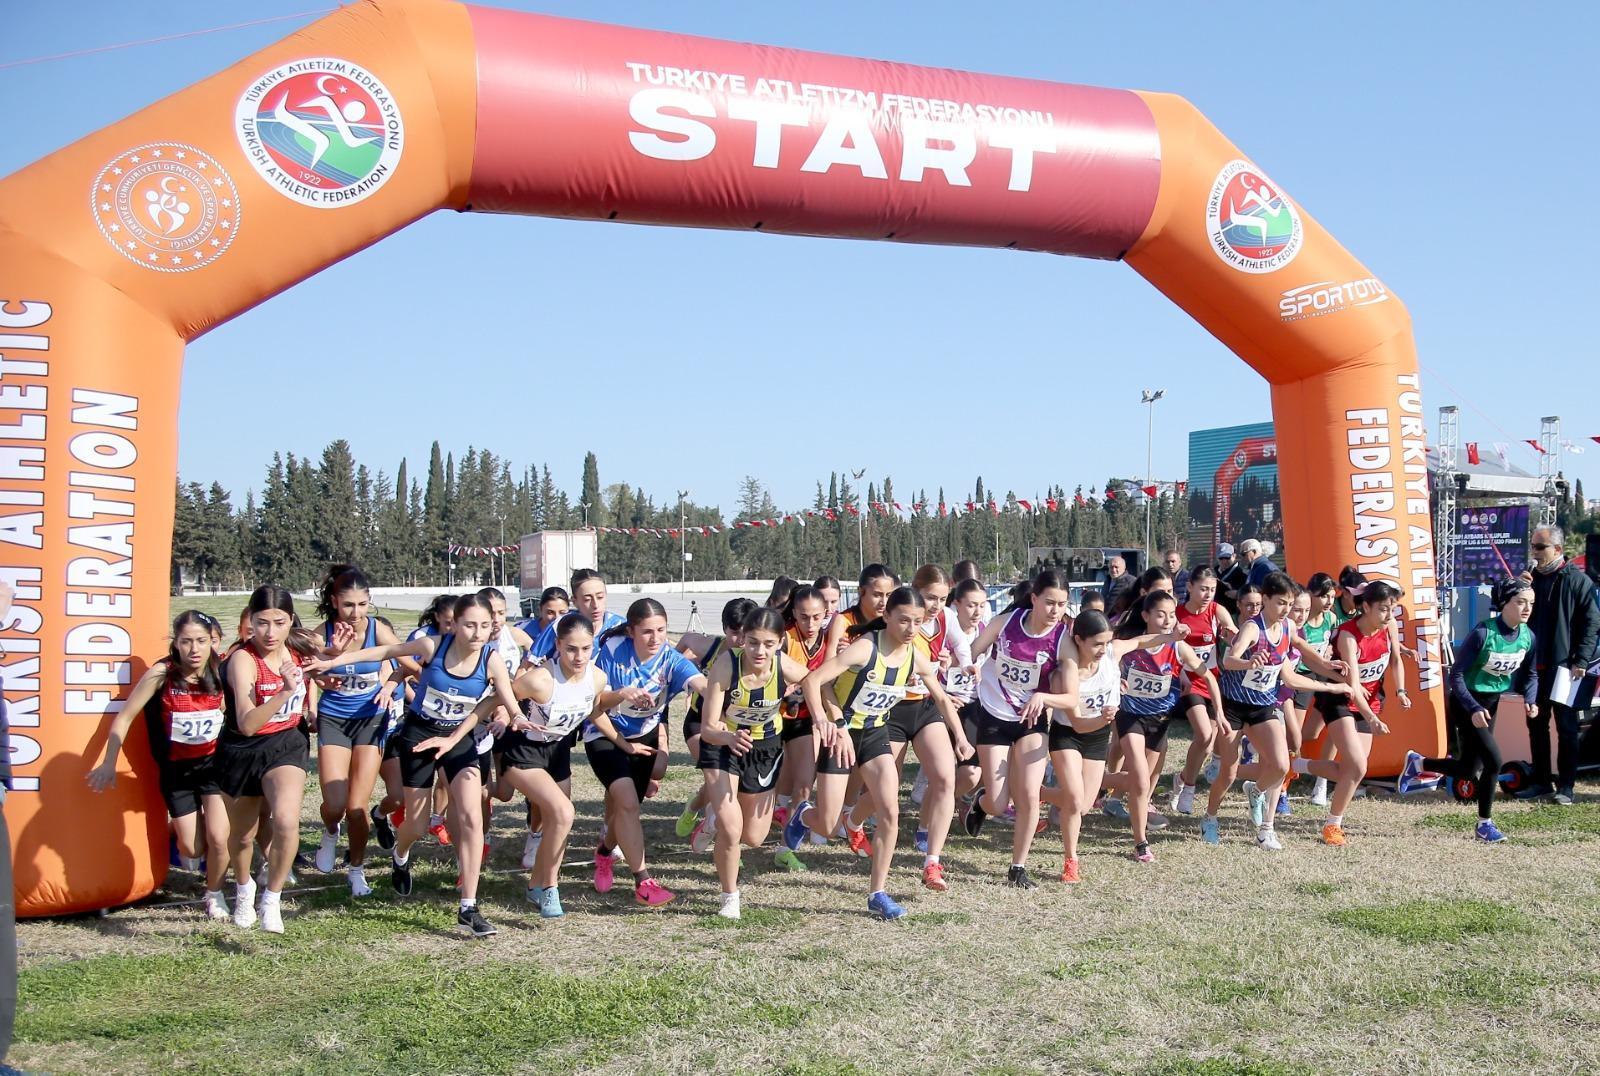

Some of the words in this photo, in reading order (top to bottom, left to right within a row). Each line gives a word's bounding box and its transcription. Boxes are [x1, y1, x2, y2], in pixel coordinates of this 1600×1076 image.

[245, 69, 286, 102] TÜRKİYE
[288, 58, 346, 74] ATLETİZM
[349, 68, 400, 151] FEDERASYONU
[881, 93, 1055, 127] FEDERASYONU
[628, 89, 1057, 192] START
[242, 117, 270, 166] TURKISH
[266, 167, 319, 201] ATHLETIC
[323, 164, 388, 202] FEDERATION
[298, 170, 322, 186] 1922
[1213, 230, 1240, 262] TURKISH
[1238, 258, 1279, 269] ATHLETIC
[1258, 248, 1273, 257] 1922
[1346, 407, 1404, 642] FEDERASY
[64, 387, 139, 714] FEDERATION
[1001, 663, 1030, 684] 233
[1360, 664, 1384, 679] 250
[1491, 660, 1517, 672] 254
[1133, 678, 1163, 694] 243
[1251, 670, 1276, 686] 24
[434, 698, 465, 715] 213
[864, 691, 897, 709] 228
[1086, 690, 1112, 709] 237
[734, 709, 769, 722] 225
[182, 719, 213, 737] 212
